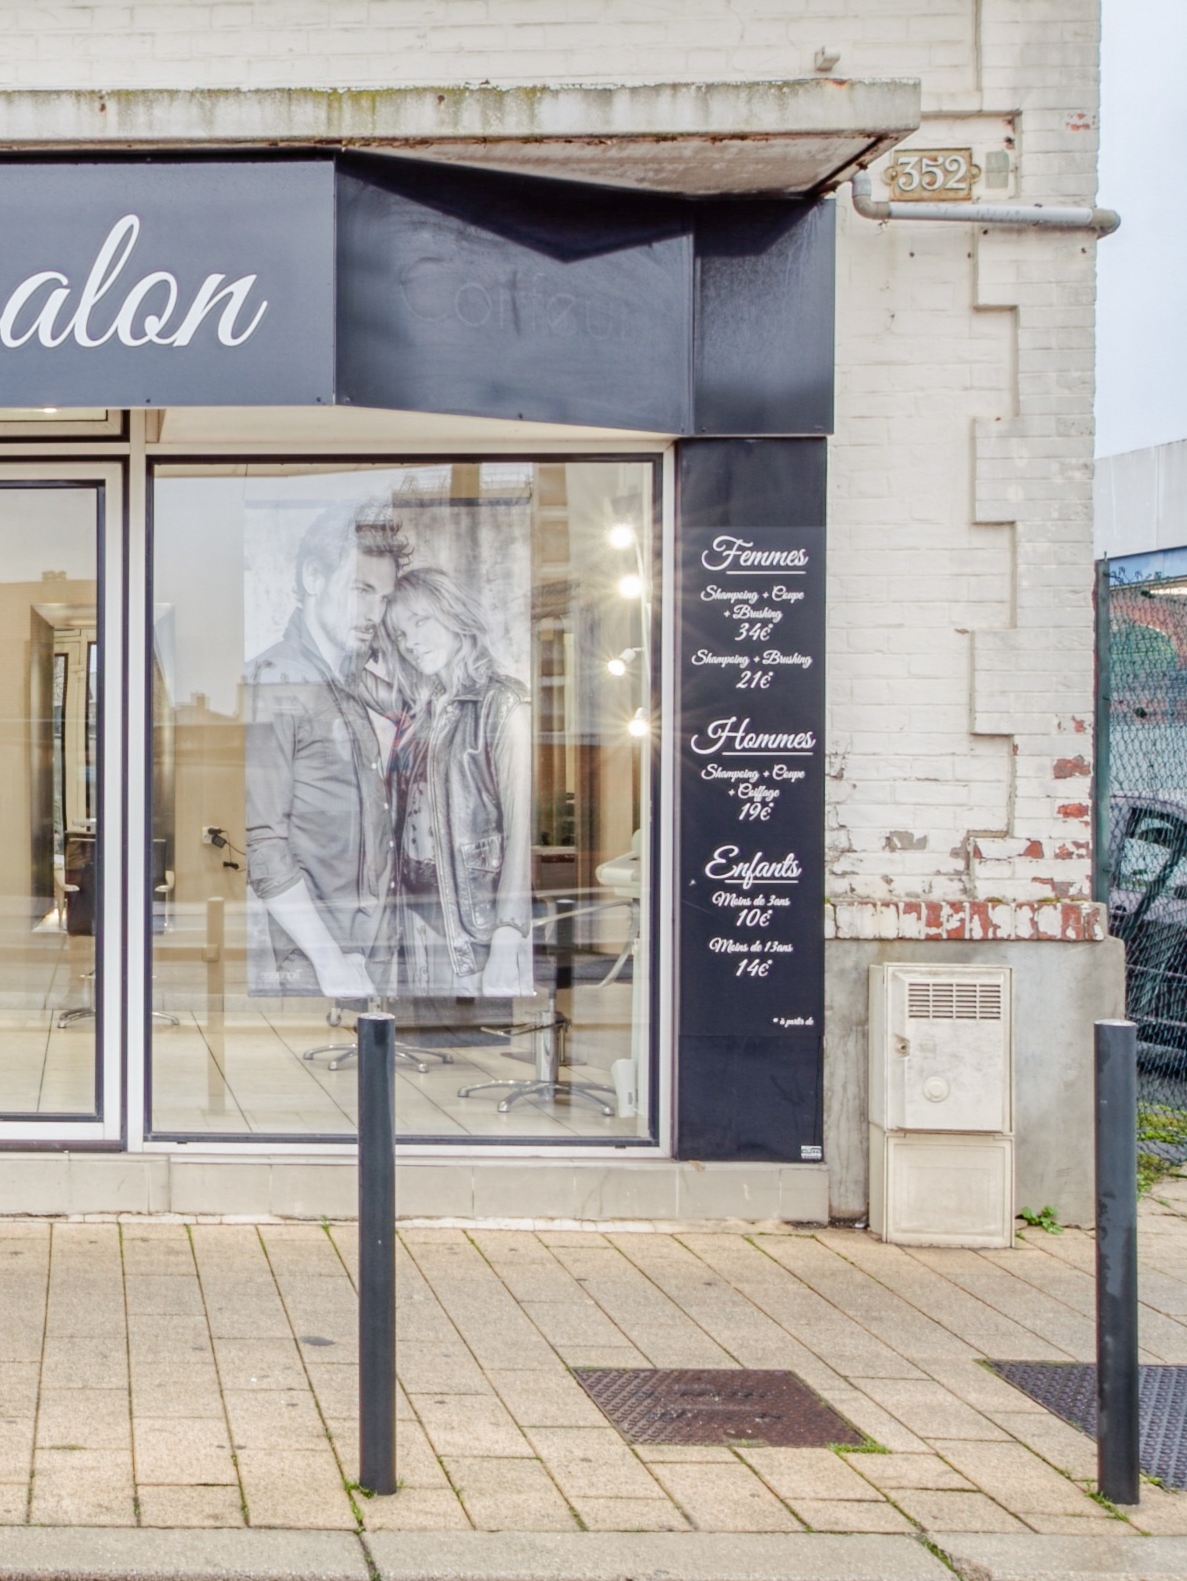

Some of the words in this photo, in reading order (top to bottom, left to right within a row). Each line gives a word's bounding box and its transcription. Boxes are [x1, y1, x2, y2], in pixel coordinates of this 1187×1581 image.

[896, 155, 967, 191] 352
[701, 535, 809, 571] Femmes
[700, 585, 759, 604] Shampoing
[771, 585, 804, 604] Coupe
[732, 604, 784, 623] Brushing
[691, 649, 750, 668] Shampoing
[762, 649, 813, 669] Brushing
[690, 716, 817, 755] Hommes
[701, 763, 759, 783] Shampoing
[772, 764, 806, 783] Coupe
[737, 782, 781, 802] Coiffage
[704, 845, 803, 890] Enfants
[711, 891, 752, 907] Moins
[753, 894, 766, 906] de
[709, 937, 749, 954] Moins
[750, 940, 763, 952] de
